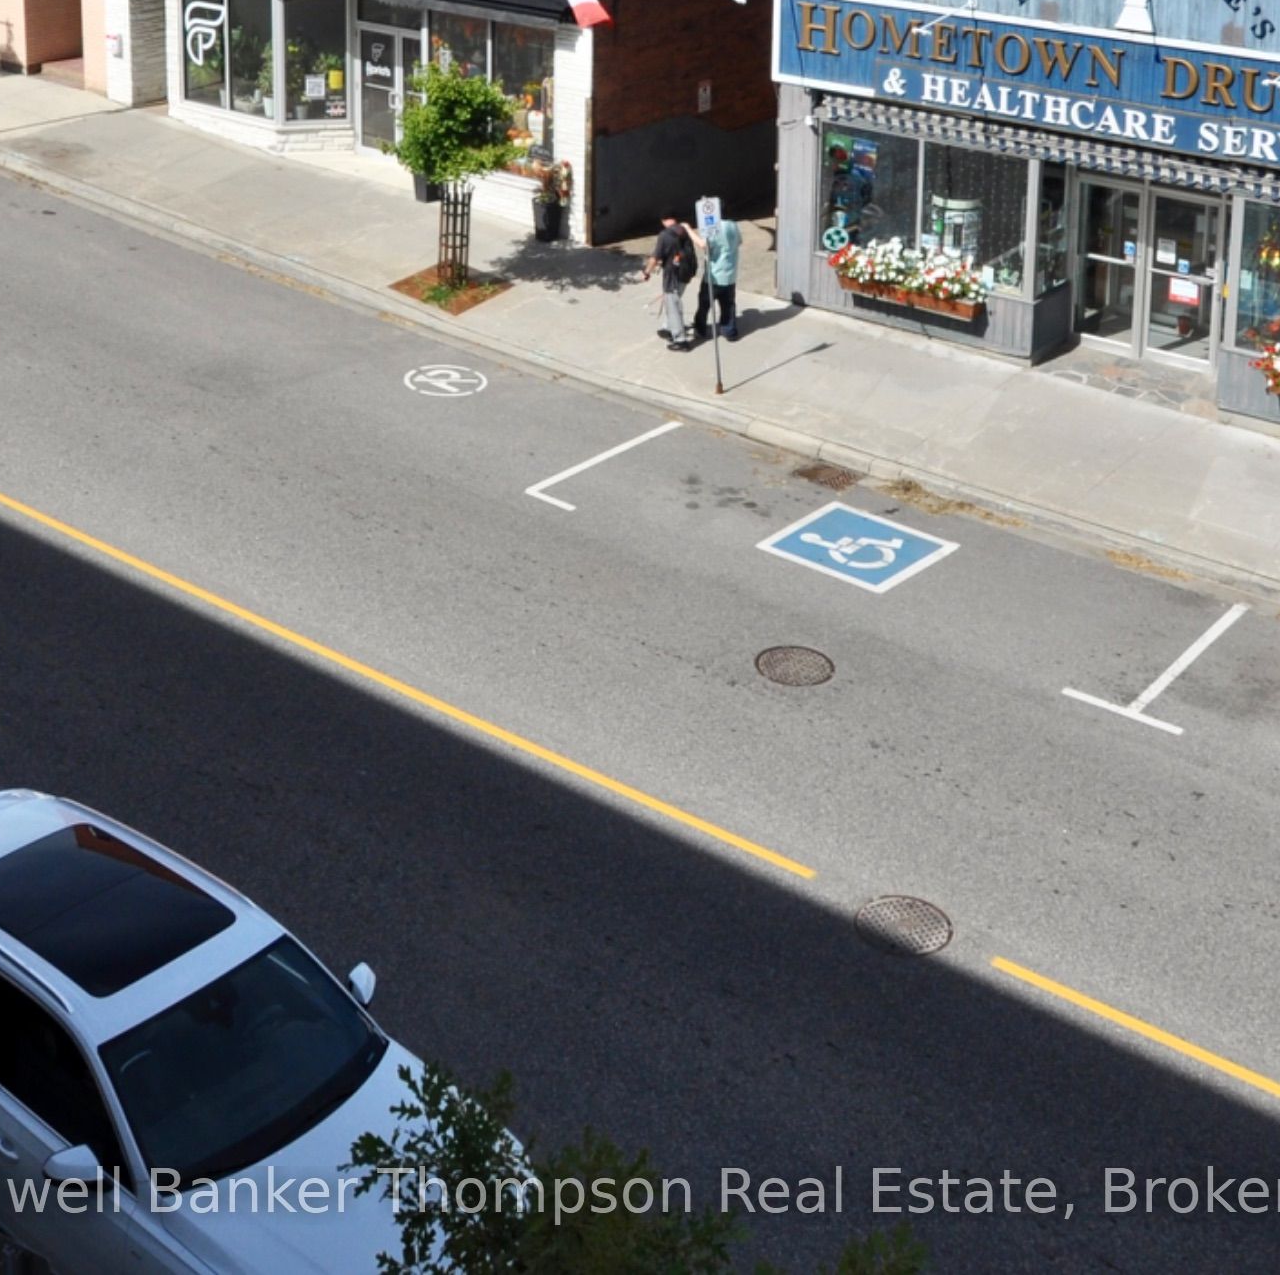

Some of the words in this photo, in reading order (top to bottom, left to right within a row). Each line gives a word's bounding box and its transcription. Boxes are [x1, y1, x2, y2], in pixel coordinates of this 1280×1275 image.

[796, 1, 1125, 89] HOMETOWN
[882, 67, 908, 96] &
[920, 73, 1177, 147] HEALTHCARE
